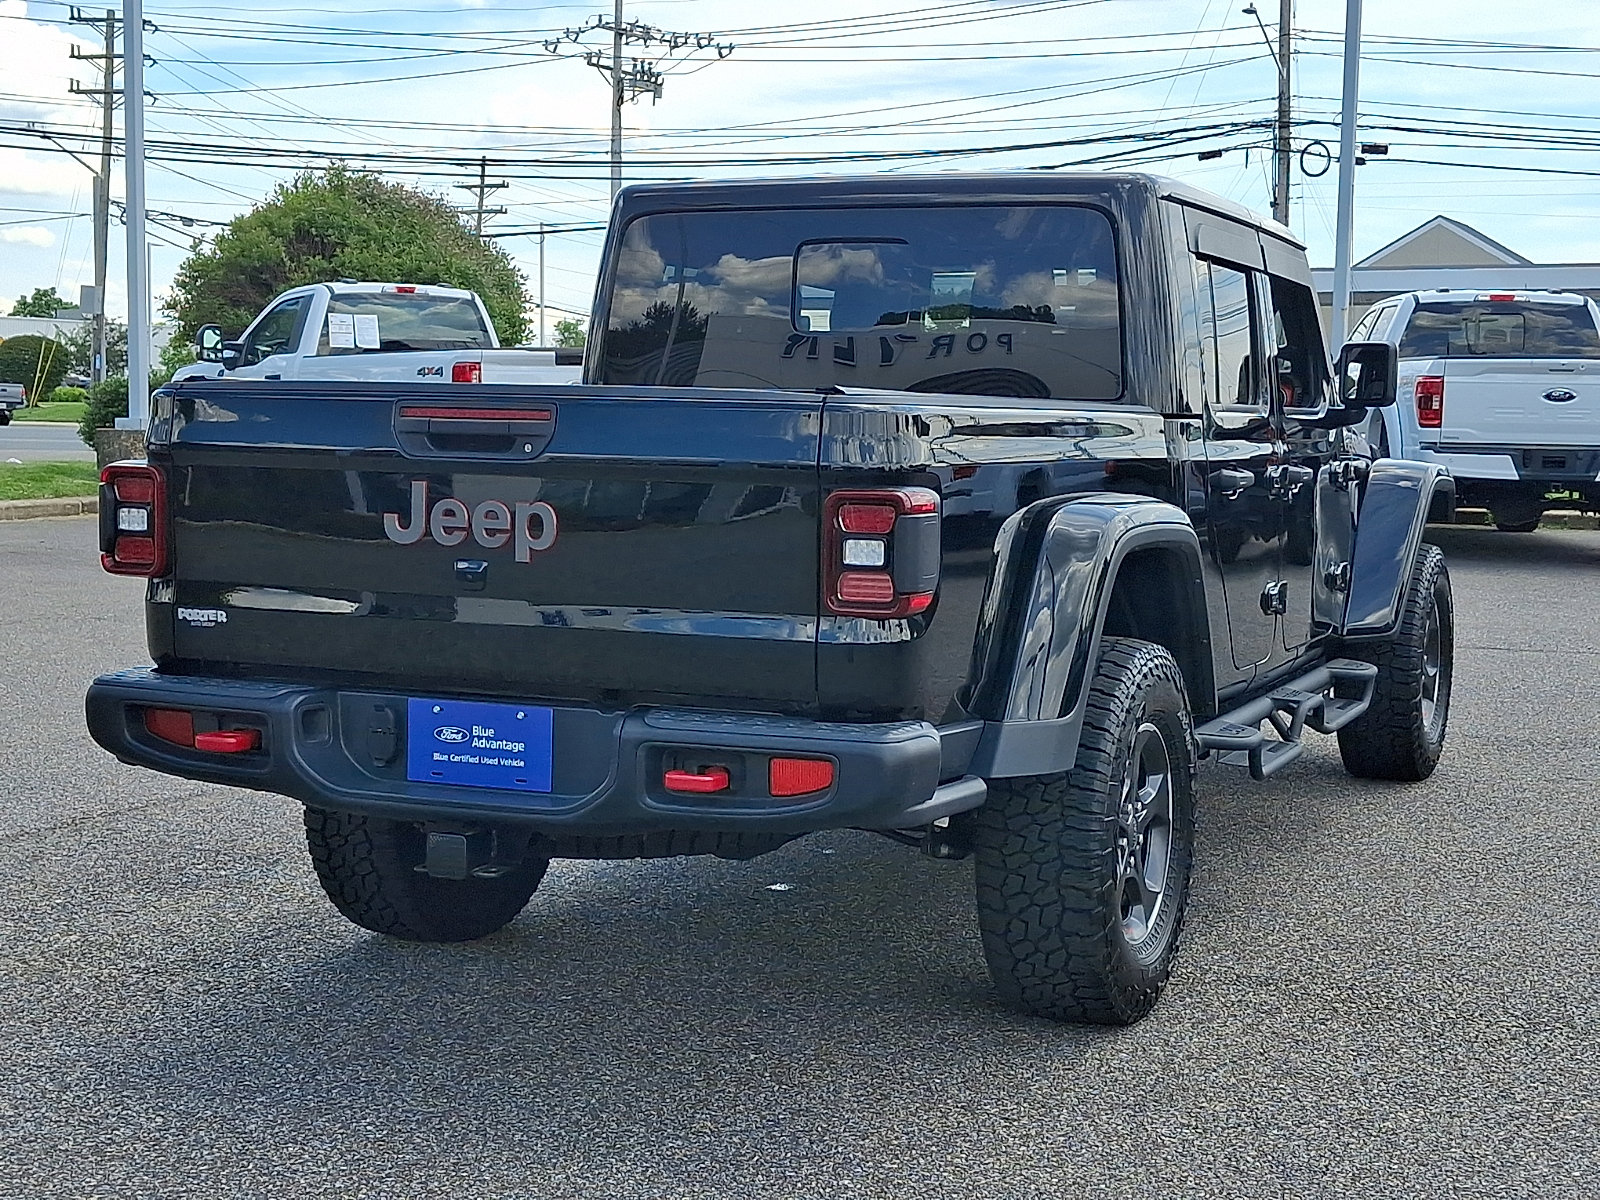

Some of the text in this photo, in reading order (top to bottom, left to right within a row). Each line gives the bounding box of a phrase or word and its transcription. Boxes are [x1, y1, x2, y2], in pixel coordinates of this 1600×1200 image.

[384, 480, 557, 563] Jeep
[472, 726, 494, 737] Blue
[472, 738, 525, 752] Advantage
[433, 753, 524, 767] Blue Certified Used Vehicle
